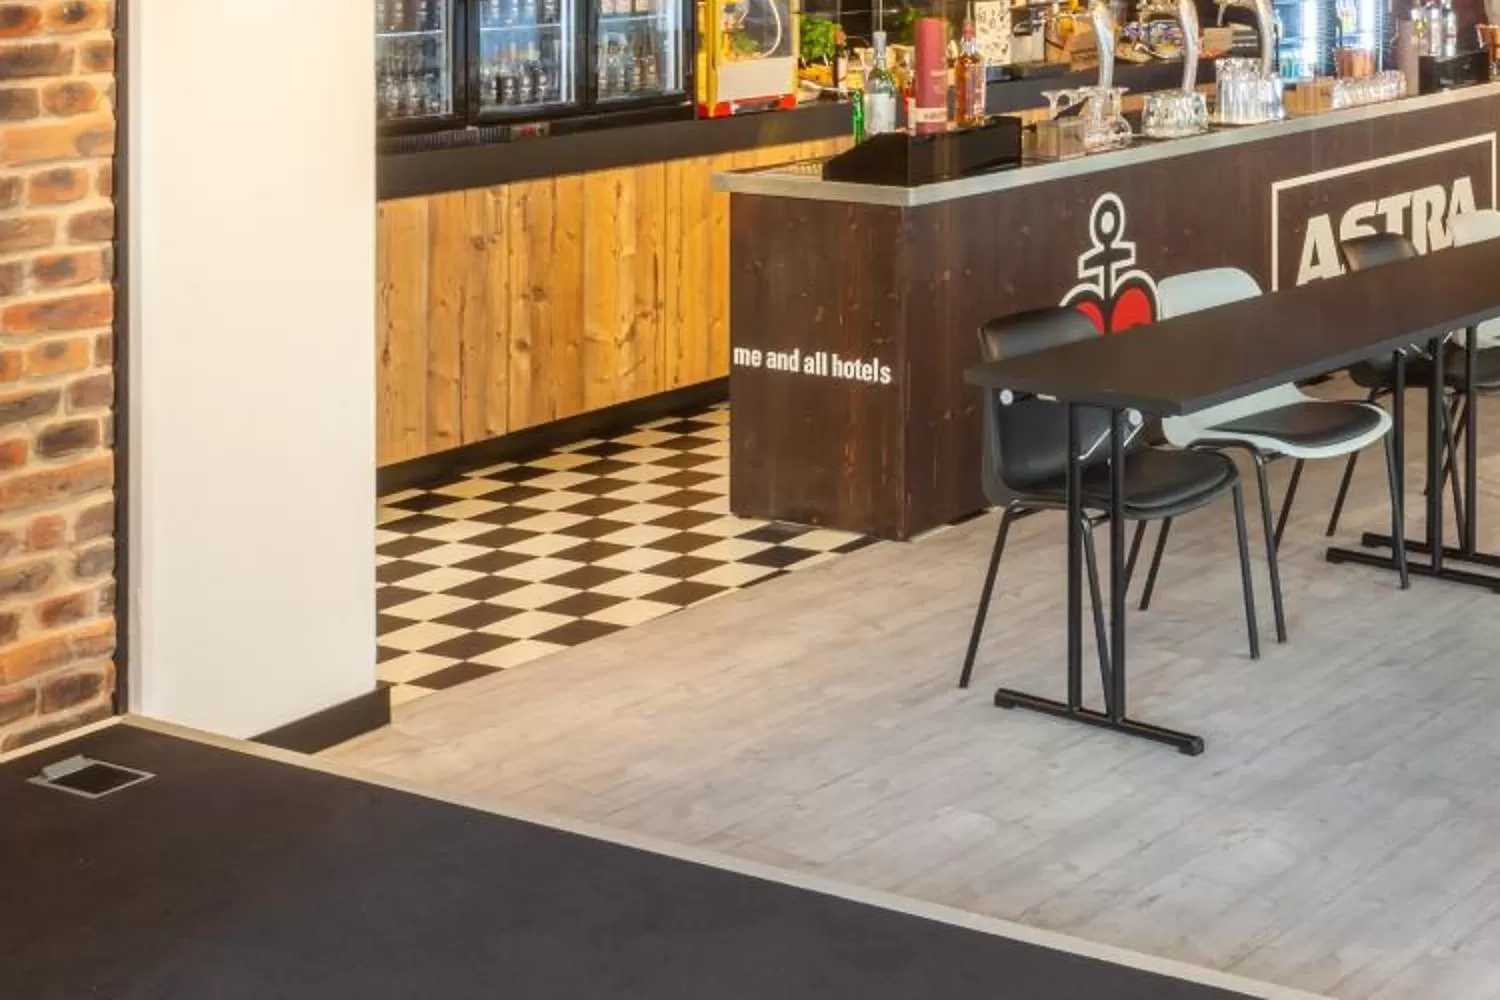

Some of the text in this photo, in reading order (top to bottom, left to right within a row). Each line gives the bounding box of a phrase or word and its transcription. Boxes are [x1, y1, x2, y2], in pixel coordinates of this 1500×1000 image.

[733, 346, 893, 385] me and all hotels
